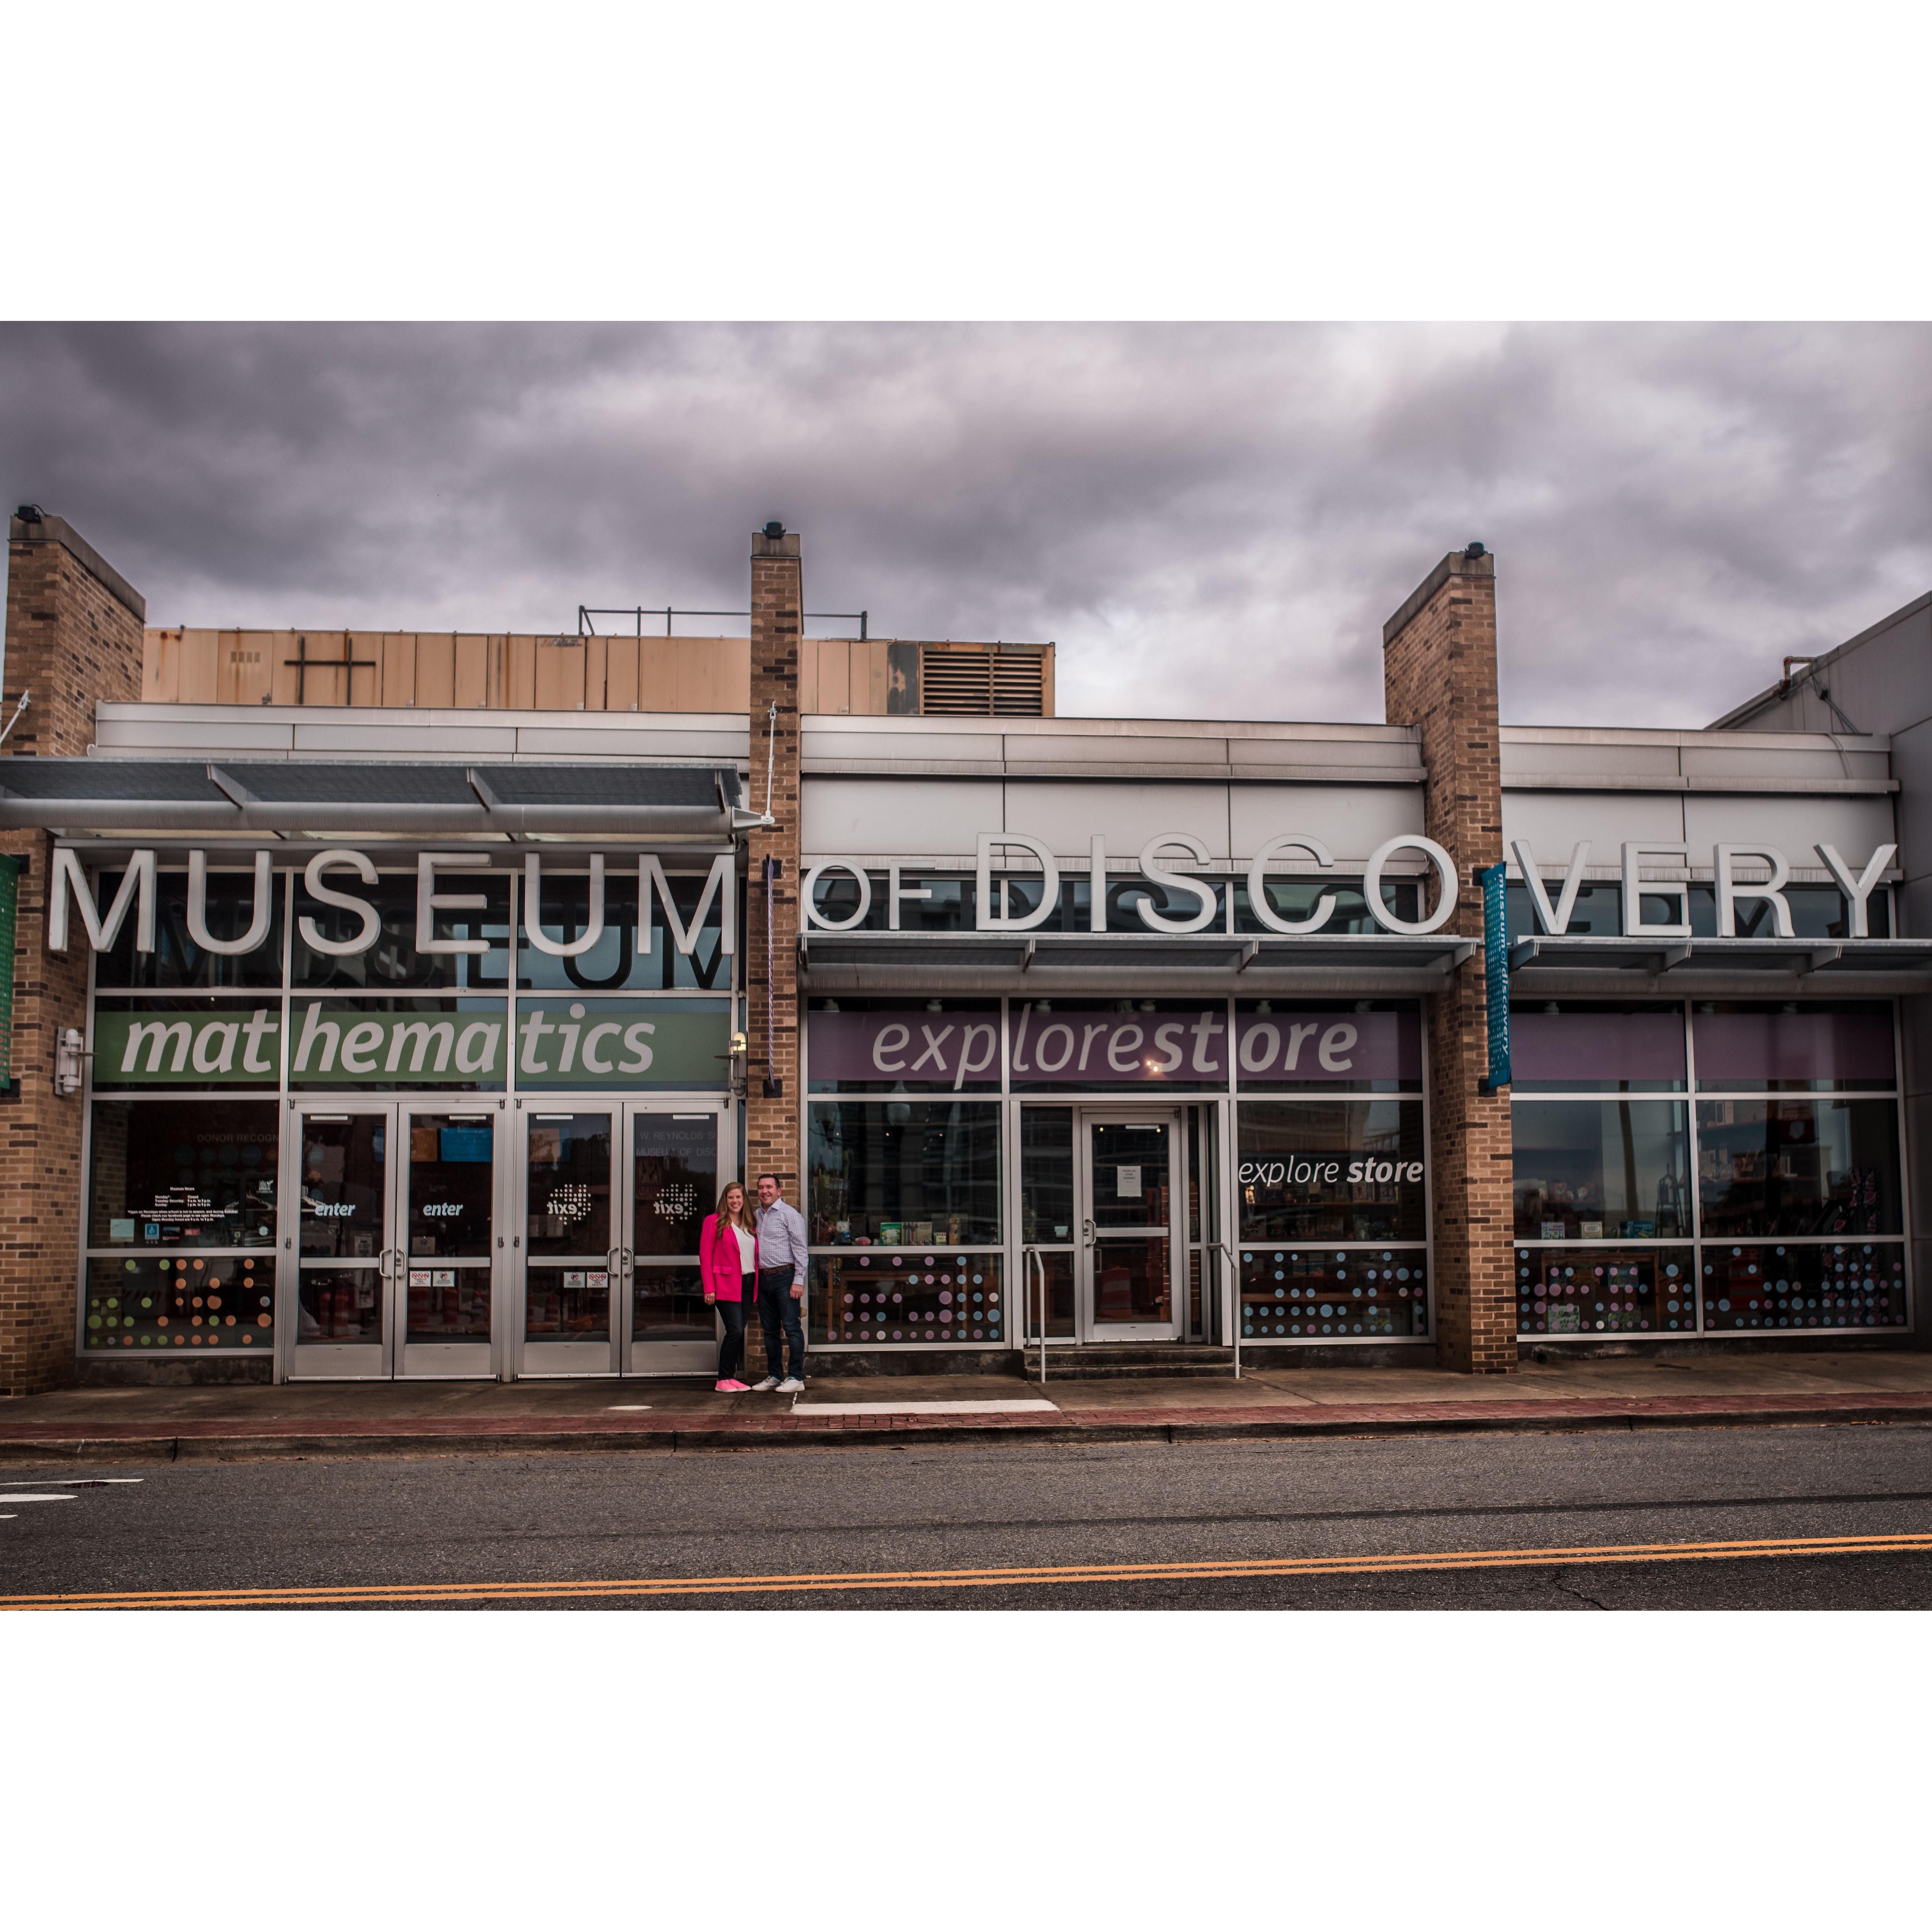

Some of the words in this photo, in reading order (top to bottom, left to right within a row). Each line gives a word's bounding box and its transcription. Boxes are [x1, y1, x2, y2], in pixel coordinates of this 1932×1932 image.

[49, 847, 735, 957] MUSEUM
[803, 857, 935, 930] OF
[121, 1002, 655, 1074] mathematics
[197, 1134, 233, 1142] DONOR
[236, 1134, 278, 1142] RECOGN
[654, 1131, 703, 1140] REYNOLDS
[637, 1148, 675, 1156] MUSEUM
[679, 1148, 692, 1156] OF
[1238, 1155, 1339, 1187] explore
[1347, 1157, 1423, 1182] store
[315, 1202, 356, 1216] enter
[423, 1202, 464, 1216] enter
